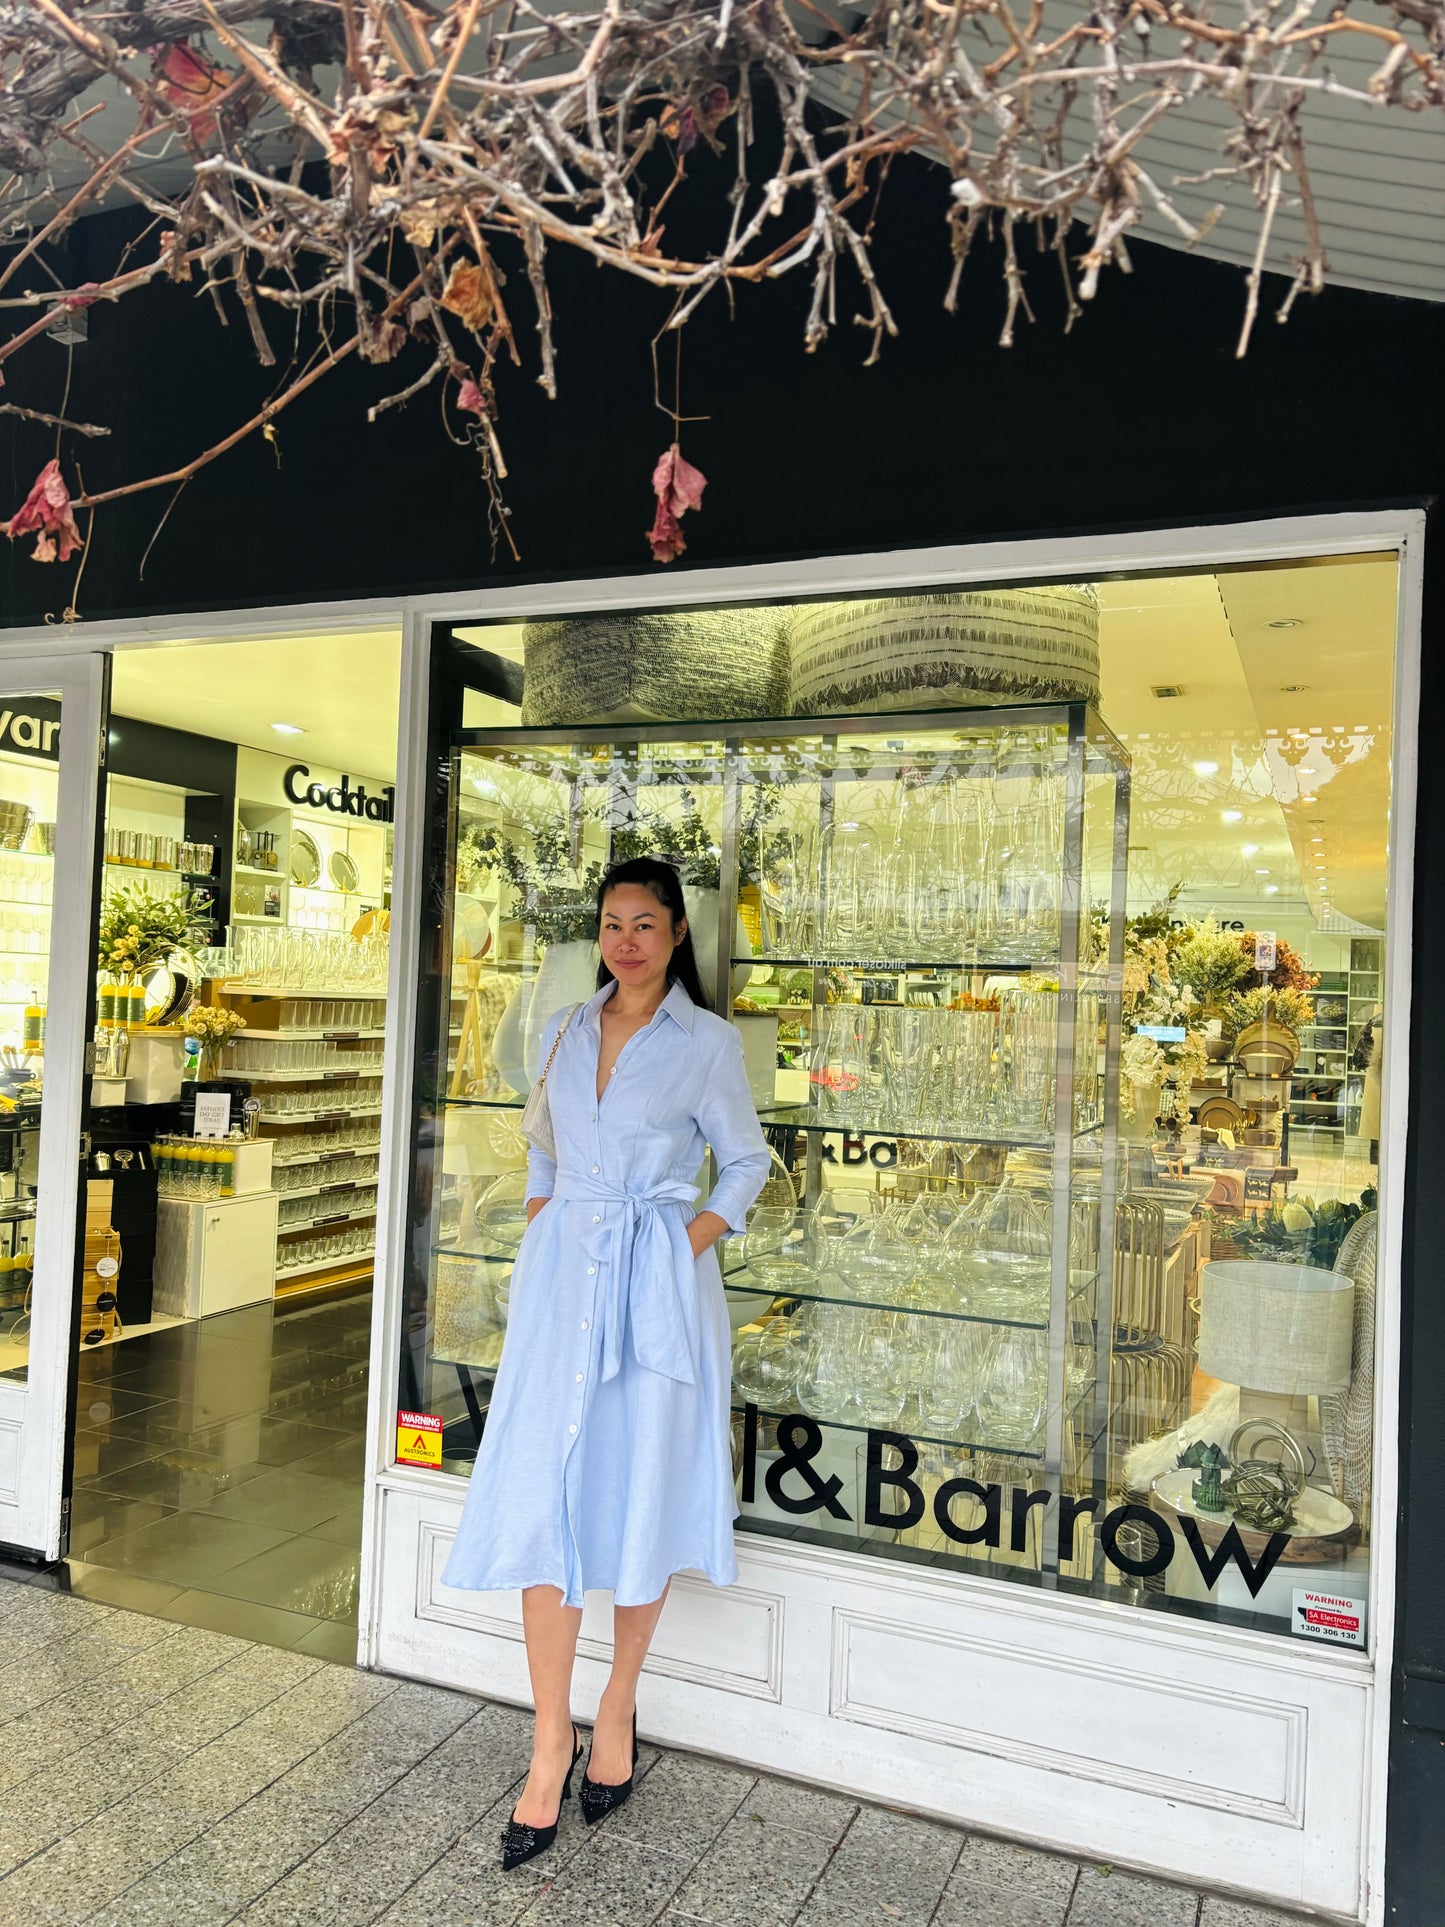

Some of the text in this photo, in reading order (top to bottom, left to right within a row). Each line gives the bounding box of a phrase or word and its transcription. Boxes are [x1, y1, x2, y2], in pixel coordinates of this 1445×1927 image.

[283, 764, 396, 823] Cocktail
[401, 1413, 440, 1427] WARNING
[1305, 1593, 1352, 1608] WARNING
[1309, 1611, 1357, 1627] SA Electronics
[1300, 1624, 1356, 1640] 1300 306 130
